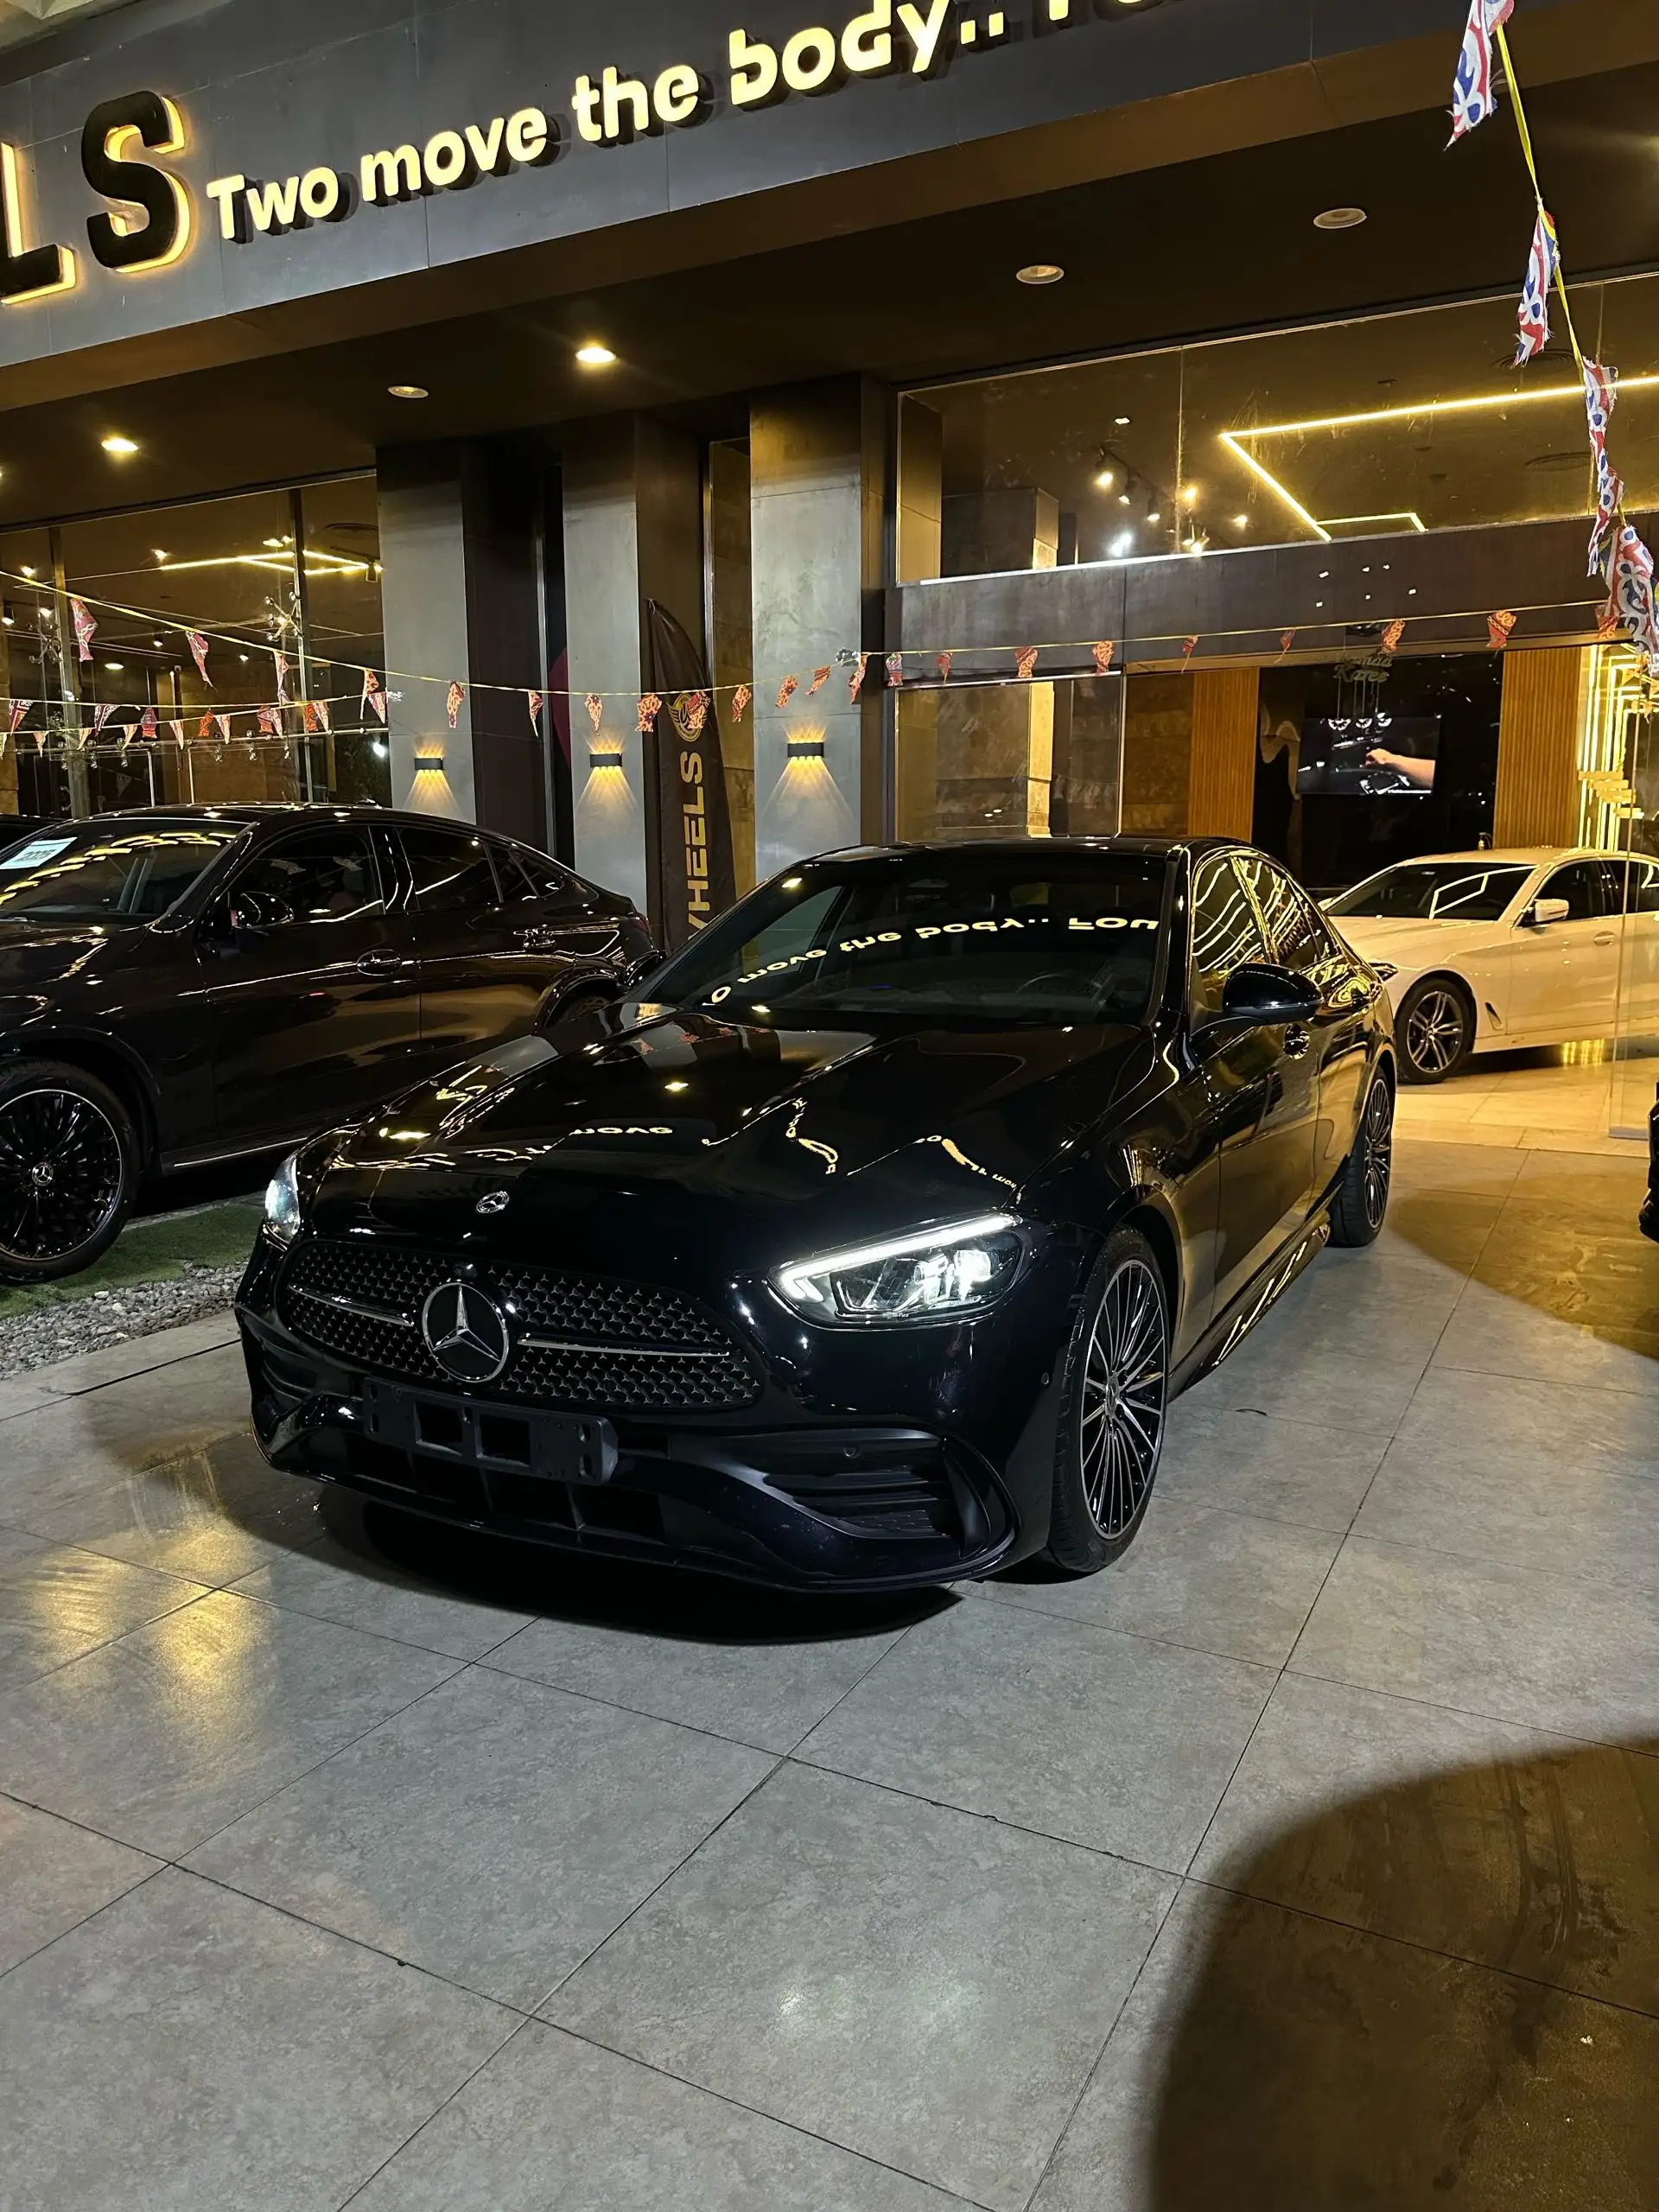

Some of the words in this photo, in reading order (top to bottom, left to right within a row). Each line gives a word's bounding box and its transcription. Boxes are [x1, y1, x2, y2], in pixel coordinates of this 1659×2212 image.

[206, 174, 339, 239] Two
[360, 107, 549, 201] move
[571, 67, 699, 142] the
